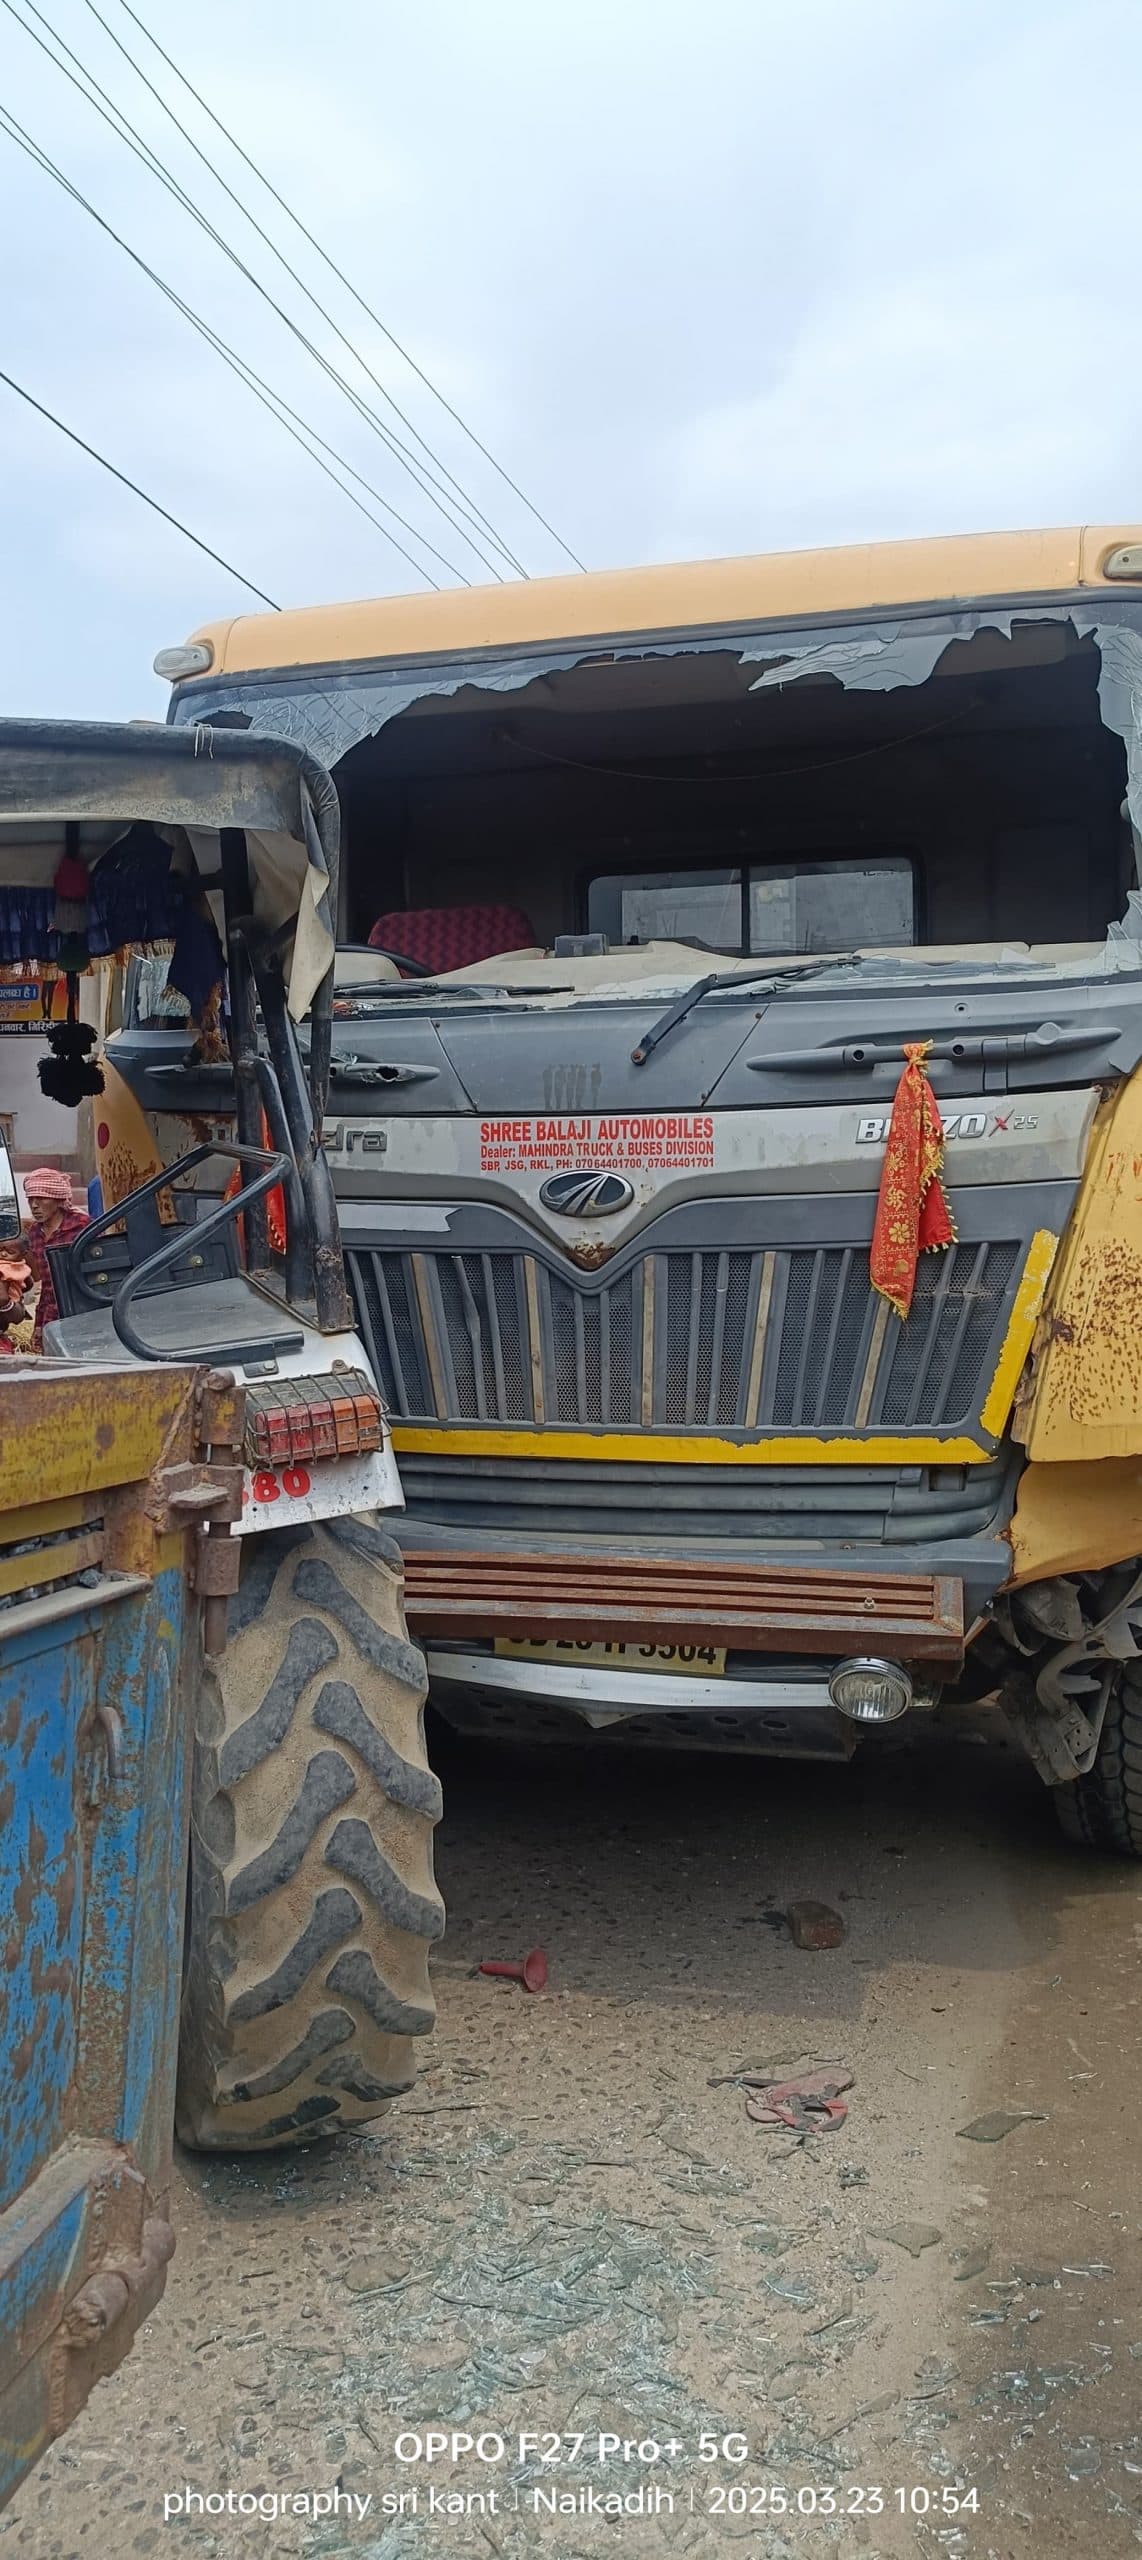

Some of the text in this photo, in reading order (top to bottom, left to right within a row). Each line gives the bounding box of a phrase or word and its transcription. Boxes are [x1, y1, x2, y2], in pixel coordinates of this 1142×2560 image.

[480, 1117, 714, 1142] SHREE BALAJI AUTOMOBILES
[855, 1113, 987, 1144] BZO
[480, 1141, 714, 1158] Dealer: MAHINDRA TRUCK & BUSES DIVISION
[504, 1160, 527, 1172] JSG,
[530, 1159, 554, 1171] RKL,
[556, 1159, 573, 1169] PH:
